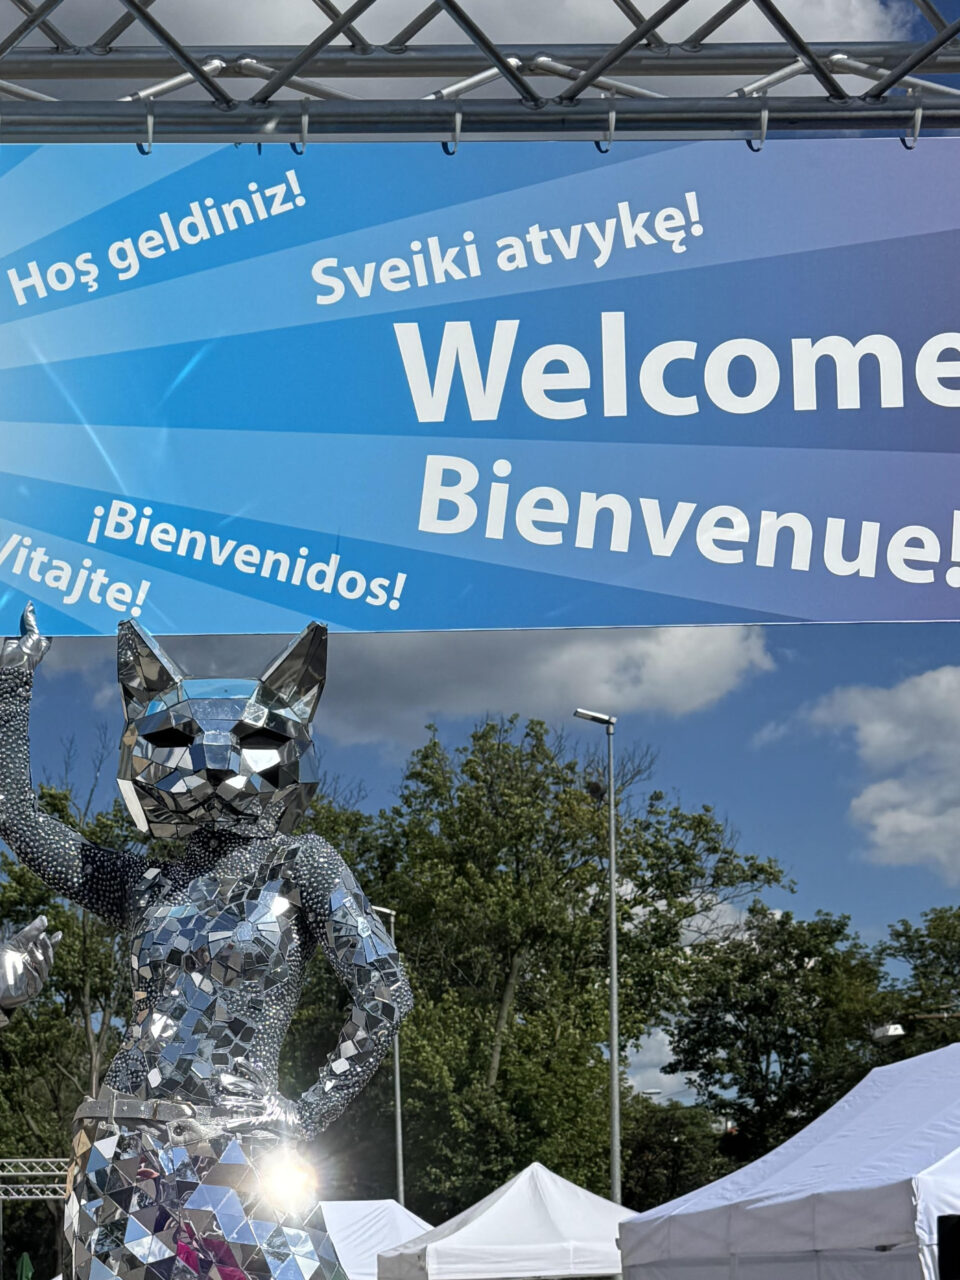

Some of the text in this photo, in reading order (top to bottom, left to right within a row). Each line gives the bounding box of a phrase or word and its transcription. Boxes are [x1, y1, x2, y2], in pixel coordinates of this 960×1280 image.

[7, 169, 307, 306] Hoş geldiniz!
[311, 191, 704, 305] Sveiki atvykę!
[393, 311, 960, 423] Welcome
[86, 499, 408, 611] ¡Bienvenidos!
[417, 454, 960, 588] Bienvenue!
